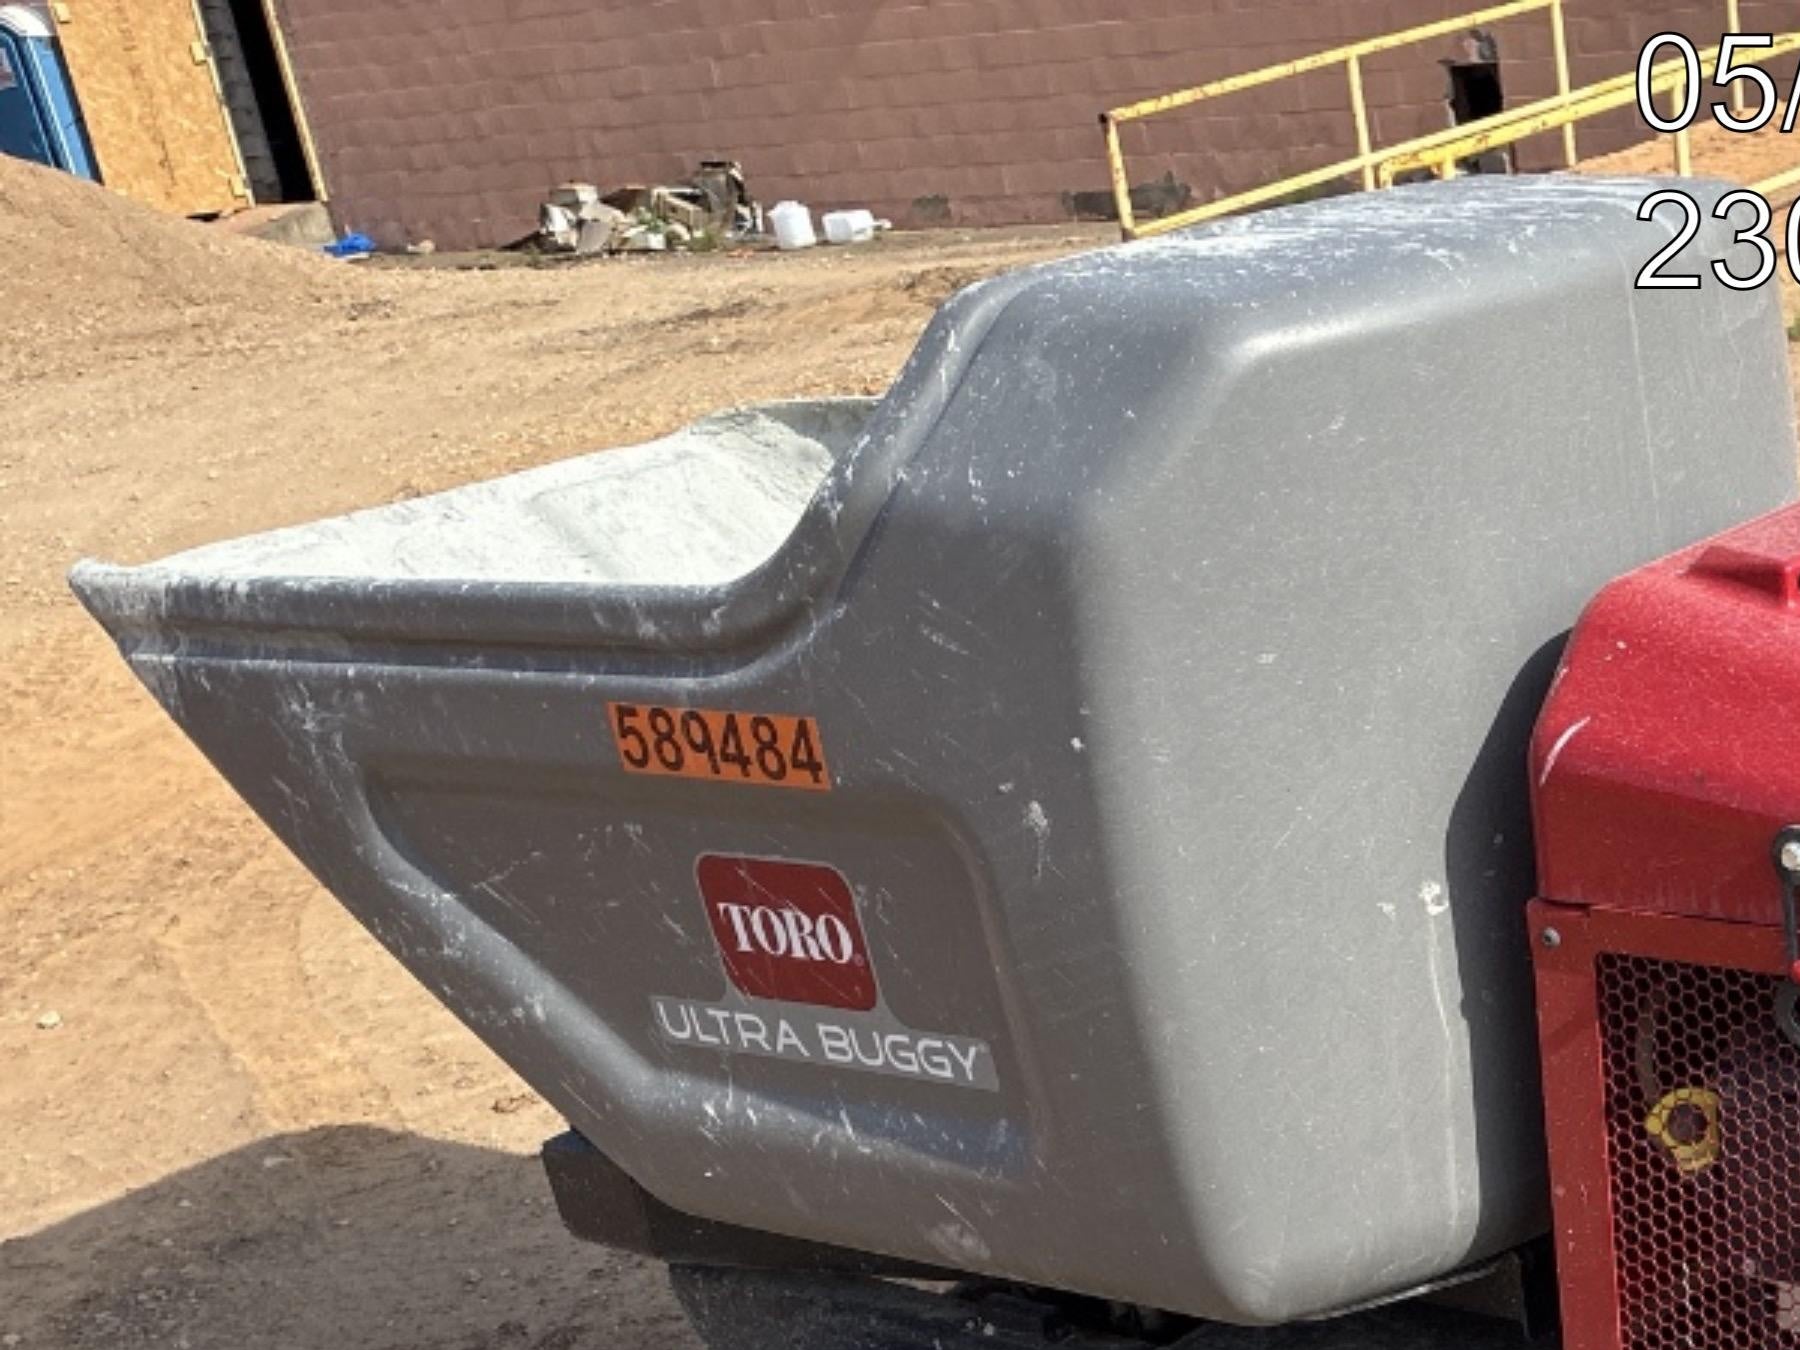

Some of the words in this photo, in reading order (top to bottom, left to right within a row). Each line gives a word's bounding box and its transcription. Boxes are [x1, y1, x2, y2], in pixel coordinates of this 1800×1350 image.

[613, 704, 823, 784] 589484
[716, 902, 854, 964] TORO
[655, 1001, 809, 1057] ULTRA
[817, 1023, 980, 1081] BUGGY
